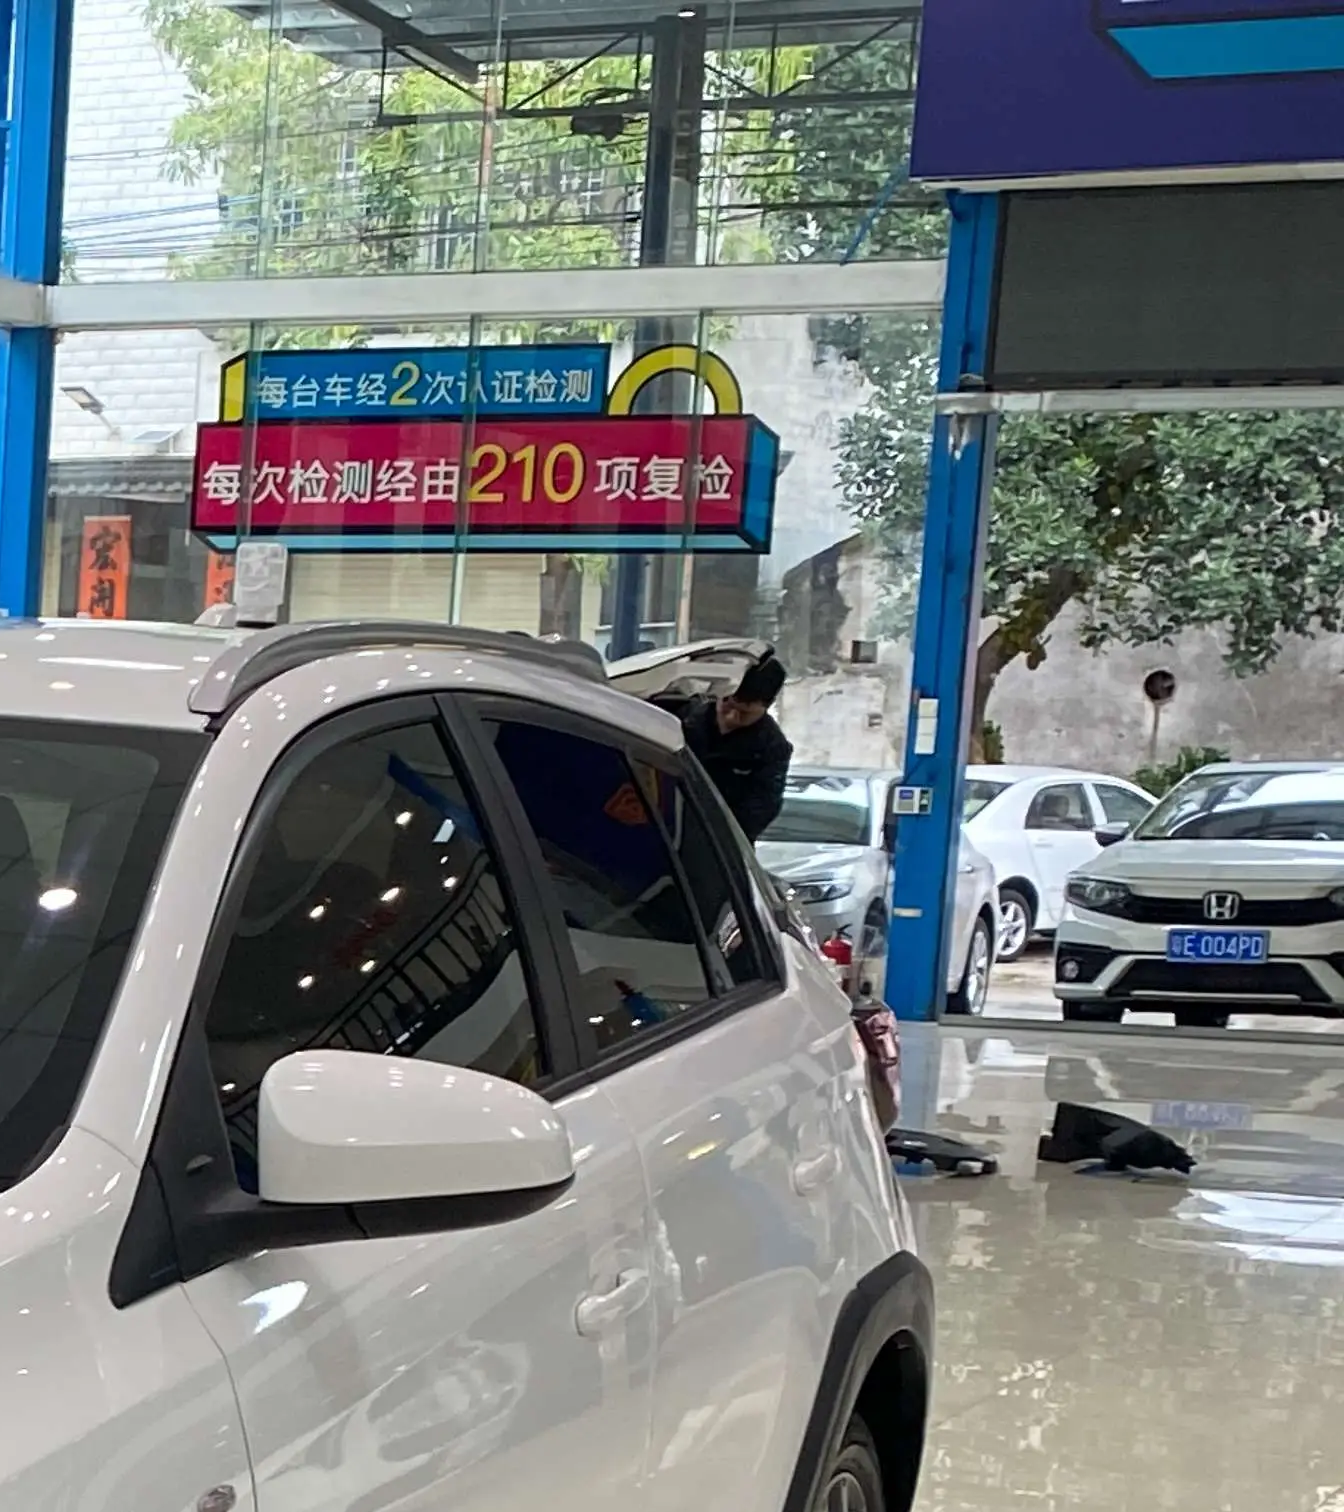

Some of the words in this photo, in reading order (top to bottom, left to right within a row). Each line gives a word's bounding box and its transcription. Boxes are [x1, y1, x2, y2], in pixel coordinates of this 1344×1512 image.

[256, 360, 593, 409] 每台车经2次认证检测
